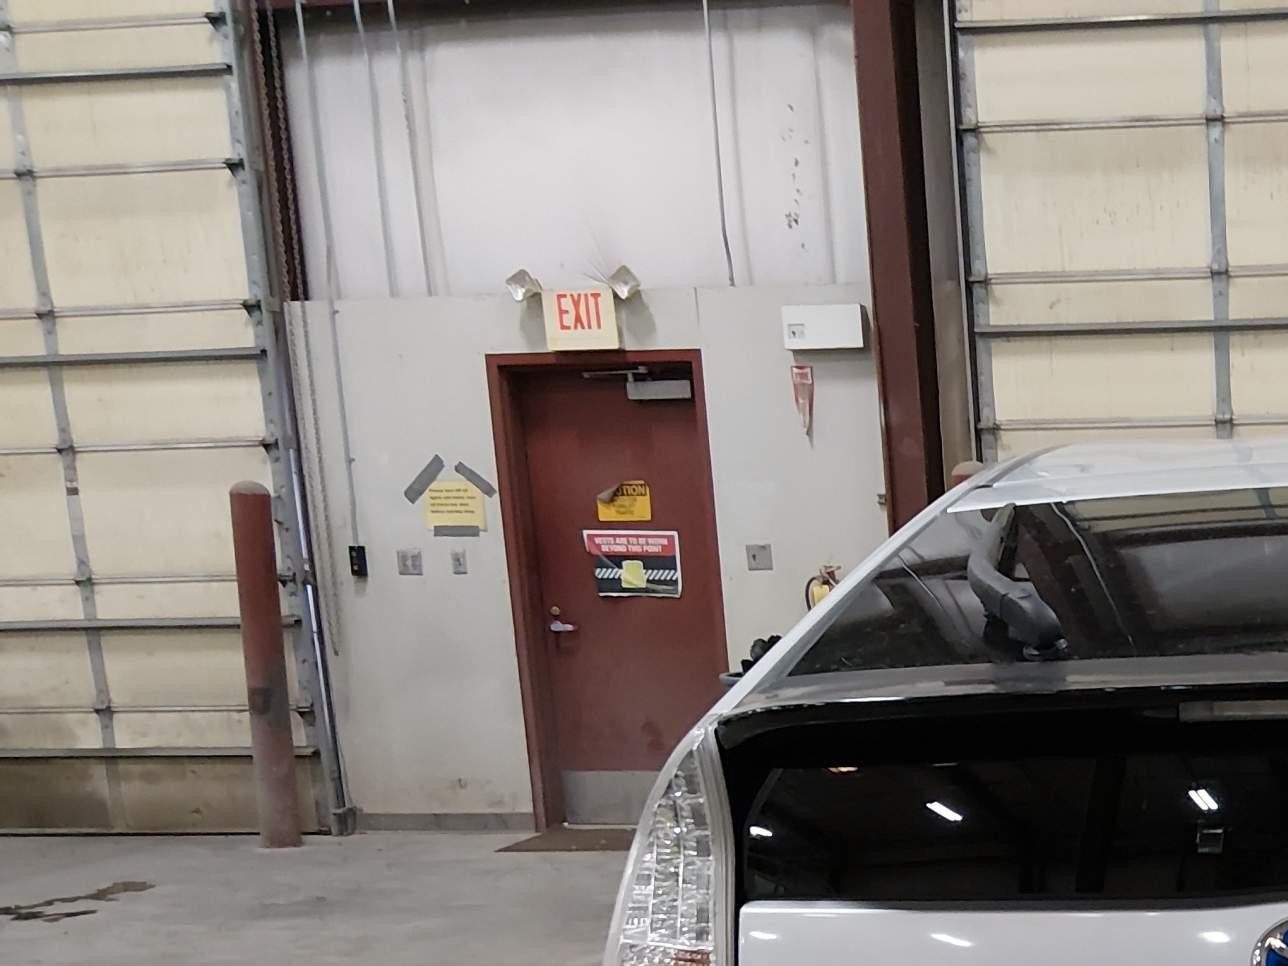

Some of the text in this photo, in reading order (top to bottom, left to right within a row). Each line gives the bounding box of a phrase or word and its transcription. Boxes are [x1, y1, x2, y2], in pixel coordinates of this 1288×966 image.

[556, 292, 602, 331] EXIT
[615, 485, 646, 495] UTION
[628, 537, 638, 545] TO
[601, 545, 662, 553] BEYOND THIS POINT
